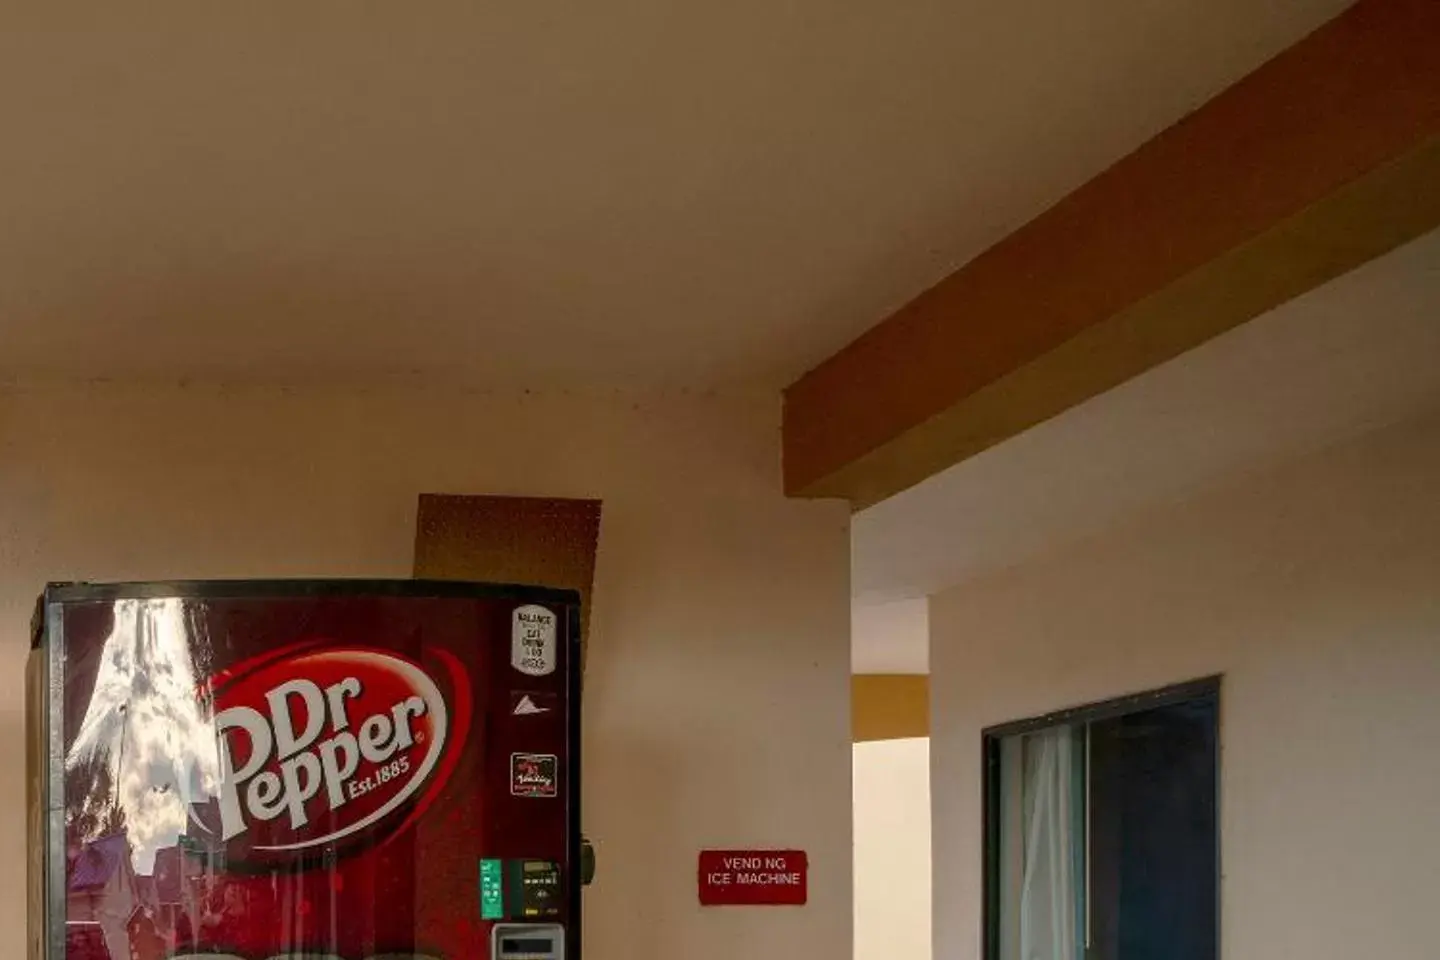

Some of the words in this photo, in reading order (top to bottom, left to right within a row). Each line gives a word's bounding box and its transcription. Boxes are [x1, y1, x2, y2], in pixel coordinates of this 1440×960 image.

[264, 677, 361, 761] Dr
[214, 696, 426, 842] Pepper
[707, 872, 731, 885] ICE
[735, 872, 801, 885] MACHINE
[723, 857, 787, 869] VENDNG
